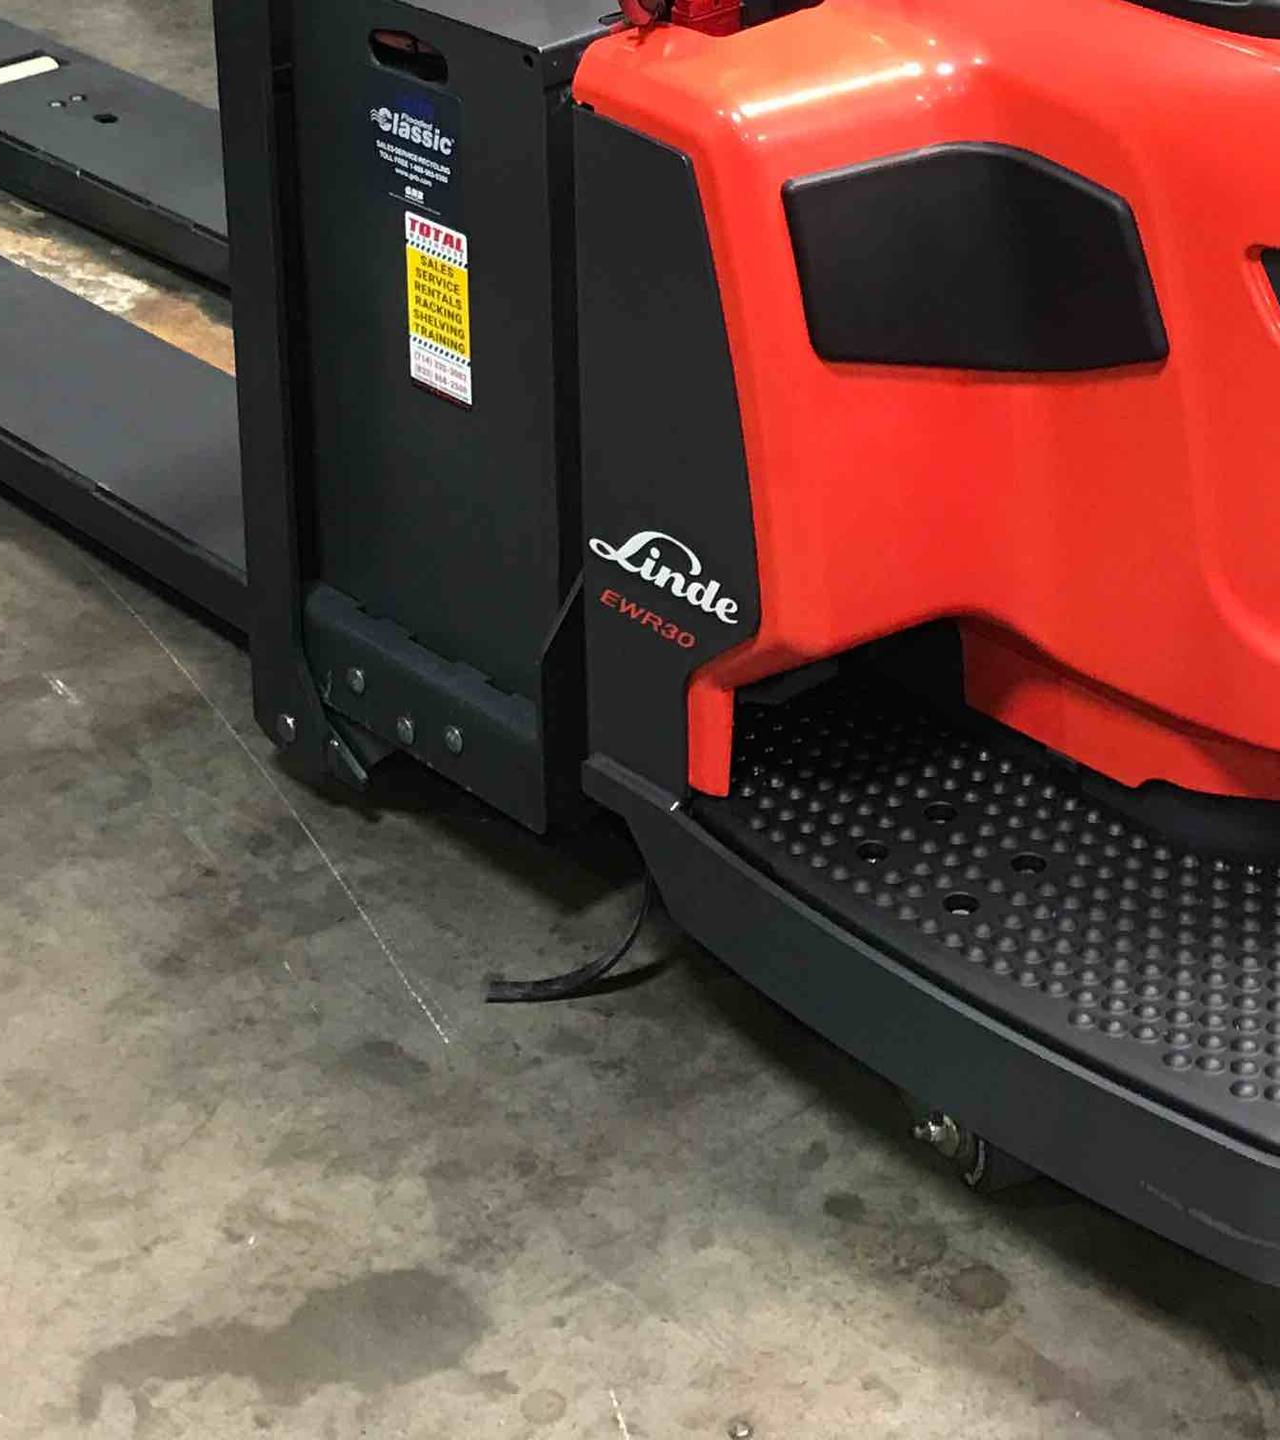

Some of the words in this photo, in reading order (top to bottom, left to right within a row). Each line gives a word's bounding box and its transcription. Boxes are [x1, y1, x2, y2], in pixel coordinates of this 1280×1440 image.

[370, 106, 453, 156] Classic
[409, 217, 464, 253] TOTAL
[415, 267, 461, 295] SERVICE
[420, 255, 454, 279] SALES
[414, 281, 463, 310] RENTALS
[415, 295, 463, 325] RACKING
[413, 308, 466, 340] SHELVING
[413, 322, 466, 355] TRAINING
[588, 530, 739, 625] Linde
[599, 588, 697, 649] EWR30
